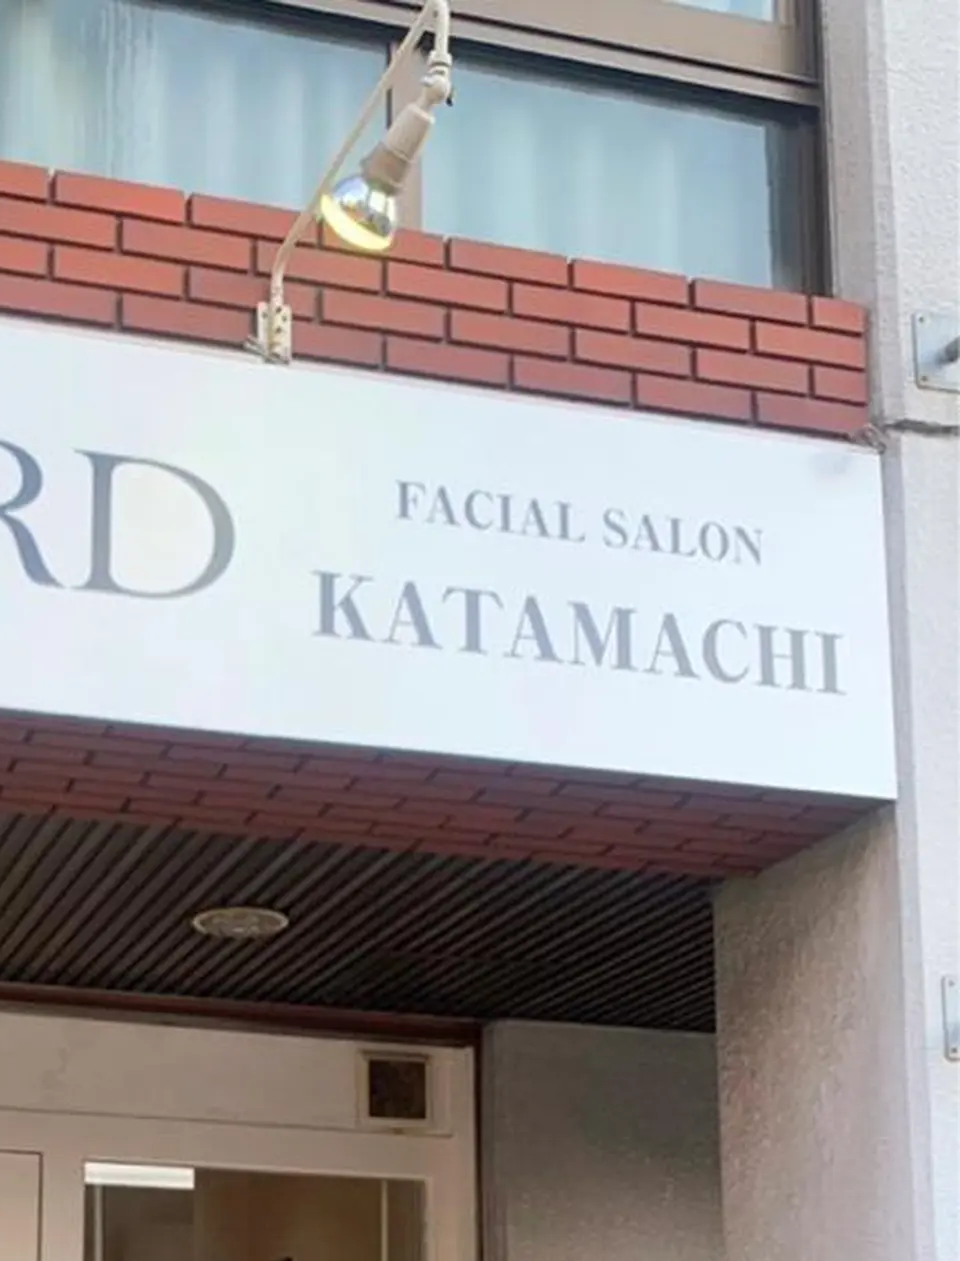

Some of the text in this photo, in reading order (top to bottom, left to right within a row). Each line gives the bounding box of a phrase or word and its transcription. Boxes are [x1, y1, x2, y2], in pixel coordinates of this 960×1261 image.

[395, 480, 764, 566] FACIAL SALON
[311, 569, 846, 695] KATAMACHI
